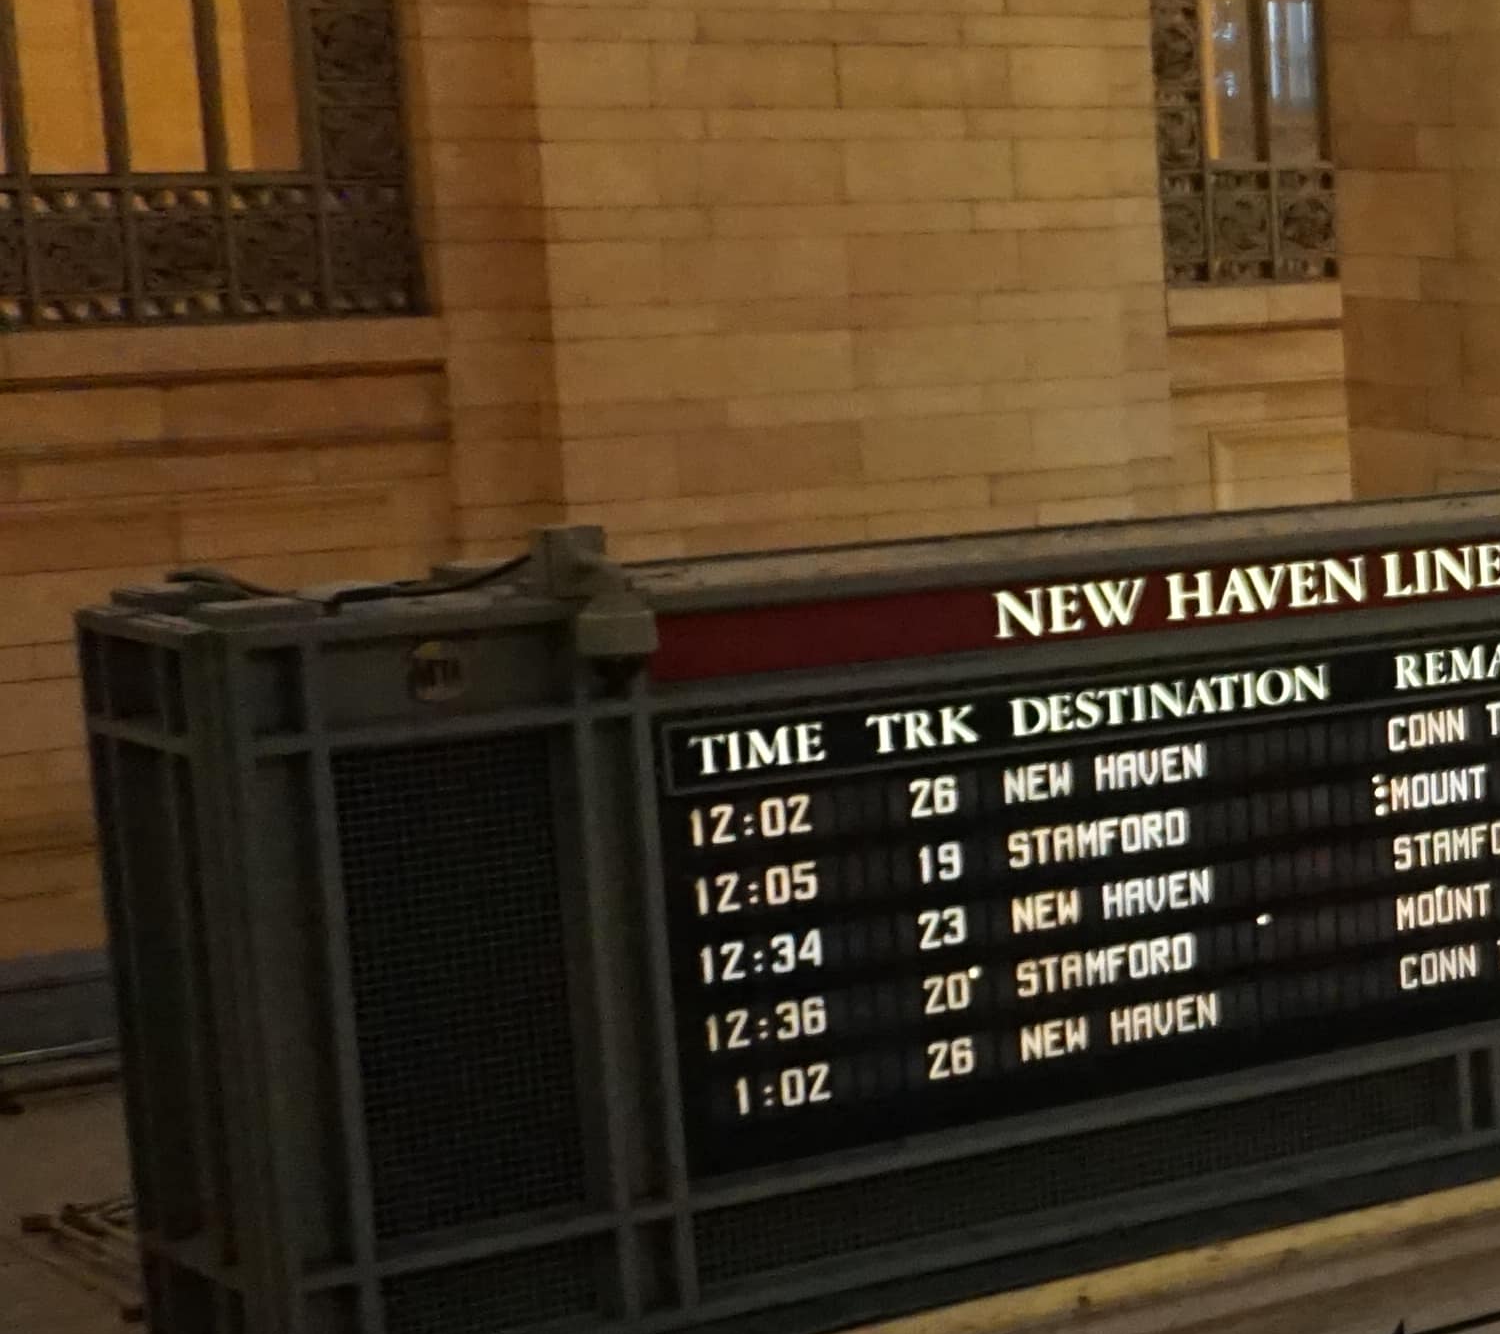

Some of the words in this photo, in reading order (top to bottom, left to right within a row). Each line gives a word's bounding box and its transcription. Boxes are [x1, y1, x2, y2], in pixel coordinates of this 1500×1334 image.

[995, 579, 1143, 638] NEW
[1166, 557, 1365, 619] HAVEN
[691, 724, 824, 773] TIME
[866, 706, 977, 753] TRK
[1010, 665, 1328, 736] DESTINATION
[692, 795, 811, 845] 12:02
[910, 777, 957, 817] 26
[1004, 762, 1072, 803] NEW
[1095, 744, 1204, 790] HAVEN
[1388, 708, 1465, 751] CONN
[697, 862, 817, 914] 12:05
[920, 842, 961, 883] 19
[1008, 810, 1187, 867] STAMFORD
[1389, 765, 1485, 813] MOUNT
[701, 930, 821, 983] 12:34
[918, 907, 965, 949] 23
[1012, 890, 1078, 933] NEW
[1103, 869, 1210, 919] HAVEN
[708, 997, 826, 1051] 12:36
[924, 968, 973, 1014] 20
[1017, 934, 1194, 996] STAMFORD
[1397, 883, 1490, 930] MOUNT
[737, 1064, 830, 1114] 1:02
[928, 1038, 973, 1079] 26
[1021, 1017, 1086, 1061] NEW
[1111, 993, 1217, 1044] HAVEN
[1400, 945, 1476, 989] CONN
